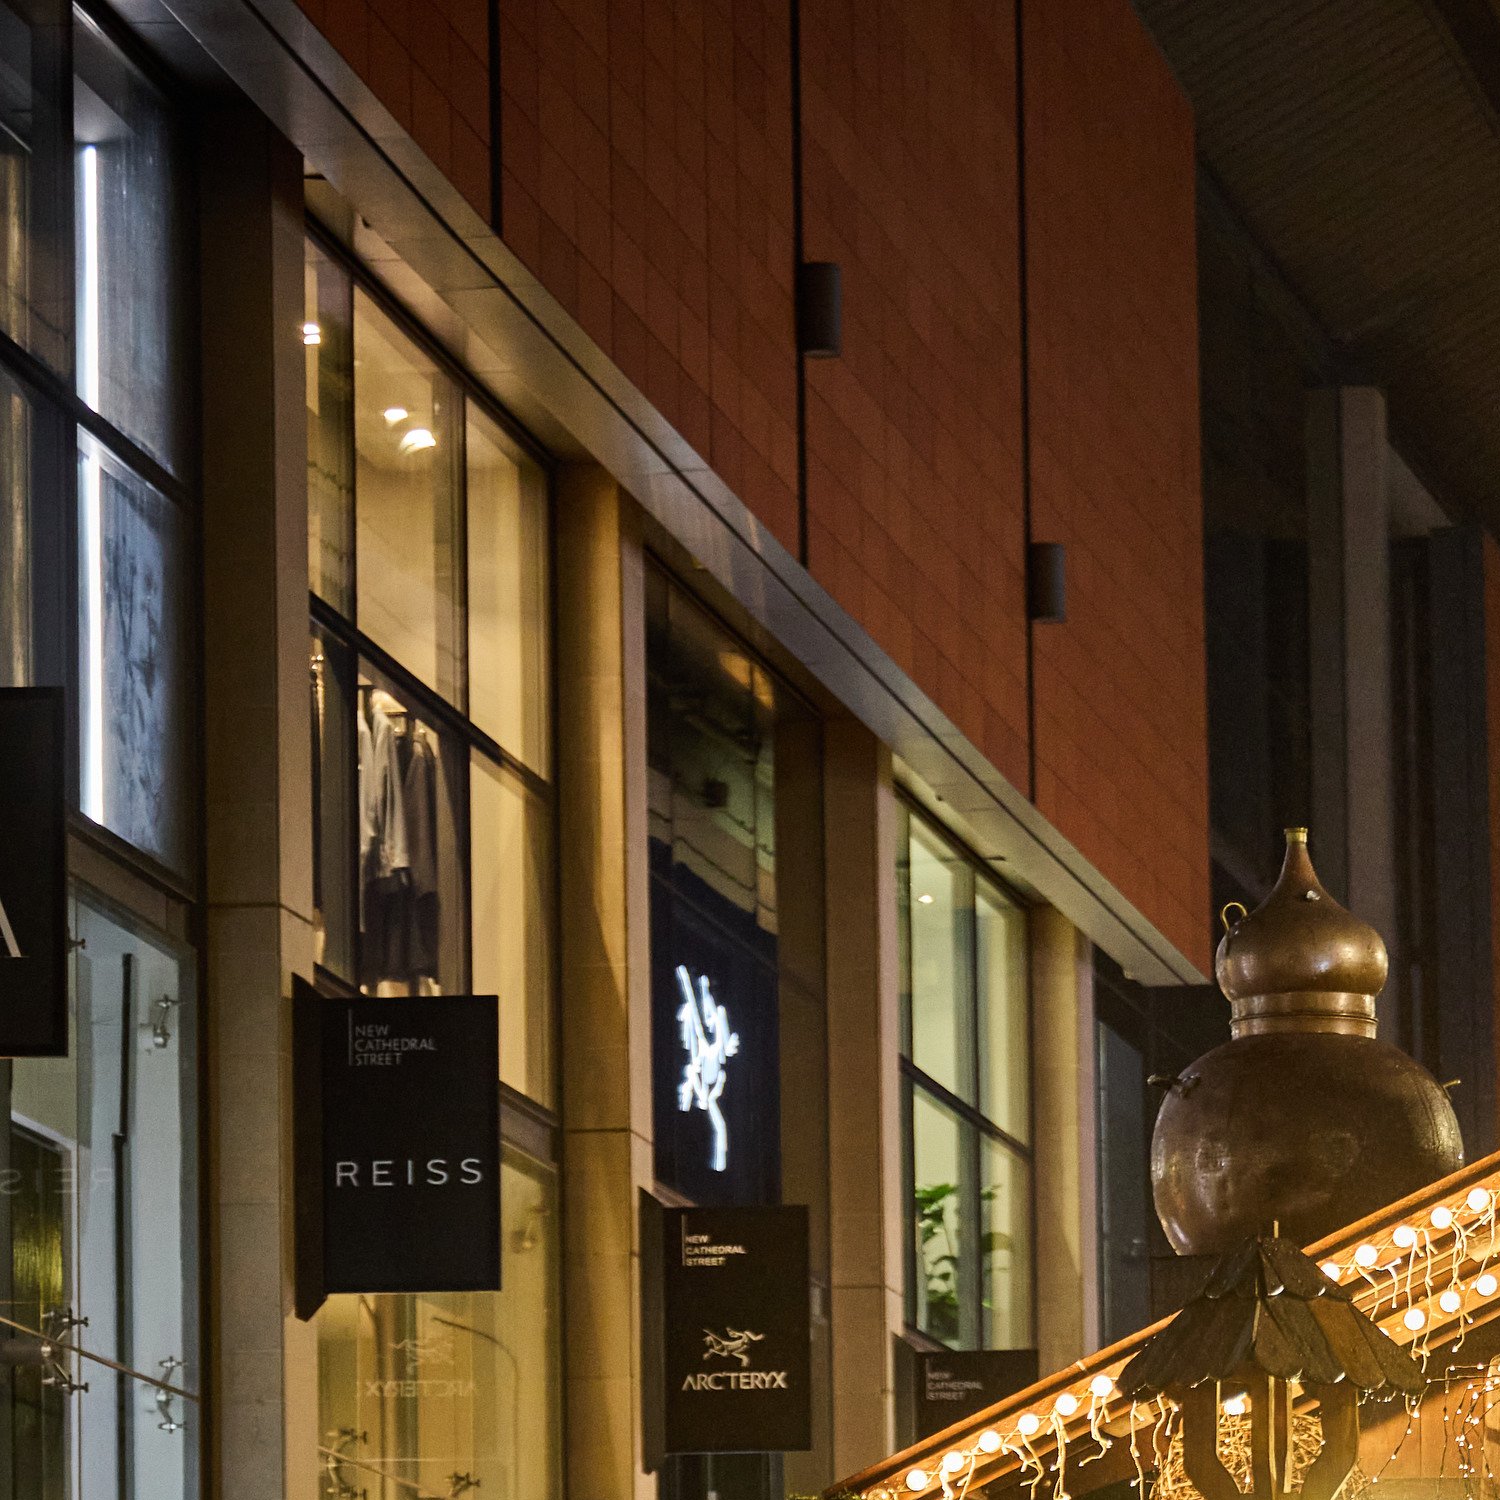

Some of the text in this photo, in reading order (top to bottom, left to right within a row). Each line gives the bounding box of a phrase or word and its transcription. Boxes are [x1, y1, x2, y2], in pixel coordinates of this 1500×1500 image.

[354, 1024, 389, 1038] NEW
[354, 1038, 438, 1051] CATHEDRAL
[356, 1052, 402, 1066] STREET
[336, 1158, 483, 1187] REISS
[685, 1235, 709, 1244] NEW
[685, 1246, 747, 1255] CATHEDRAL
[686, 1257, 726, 1266] STREET
